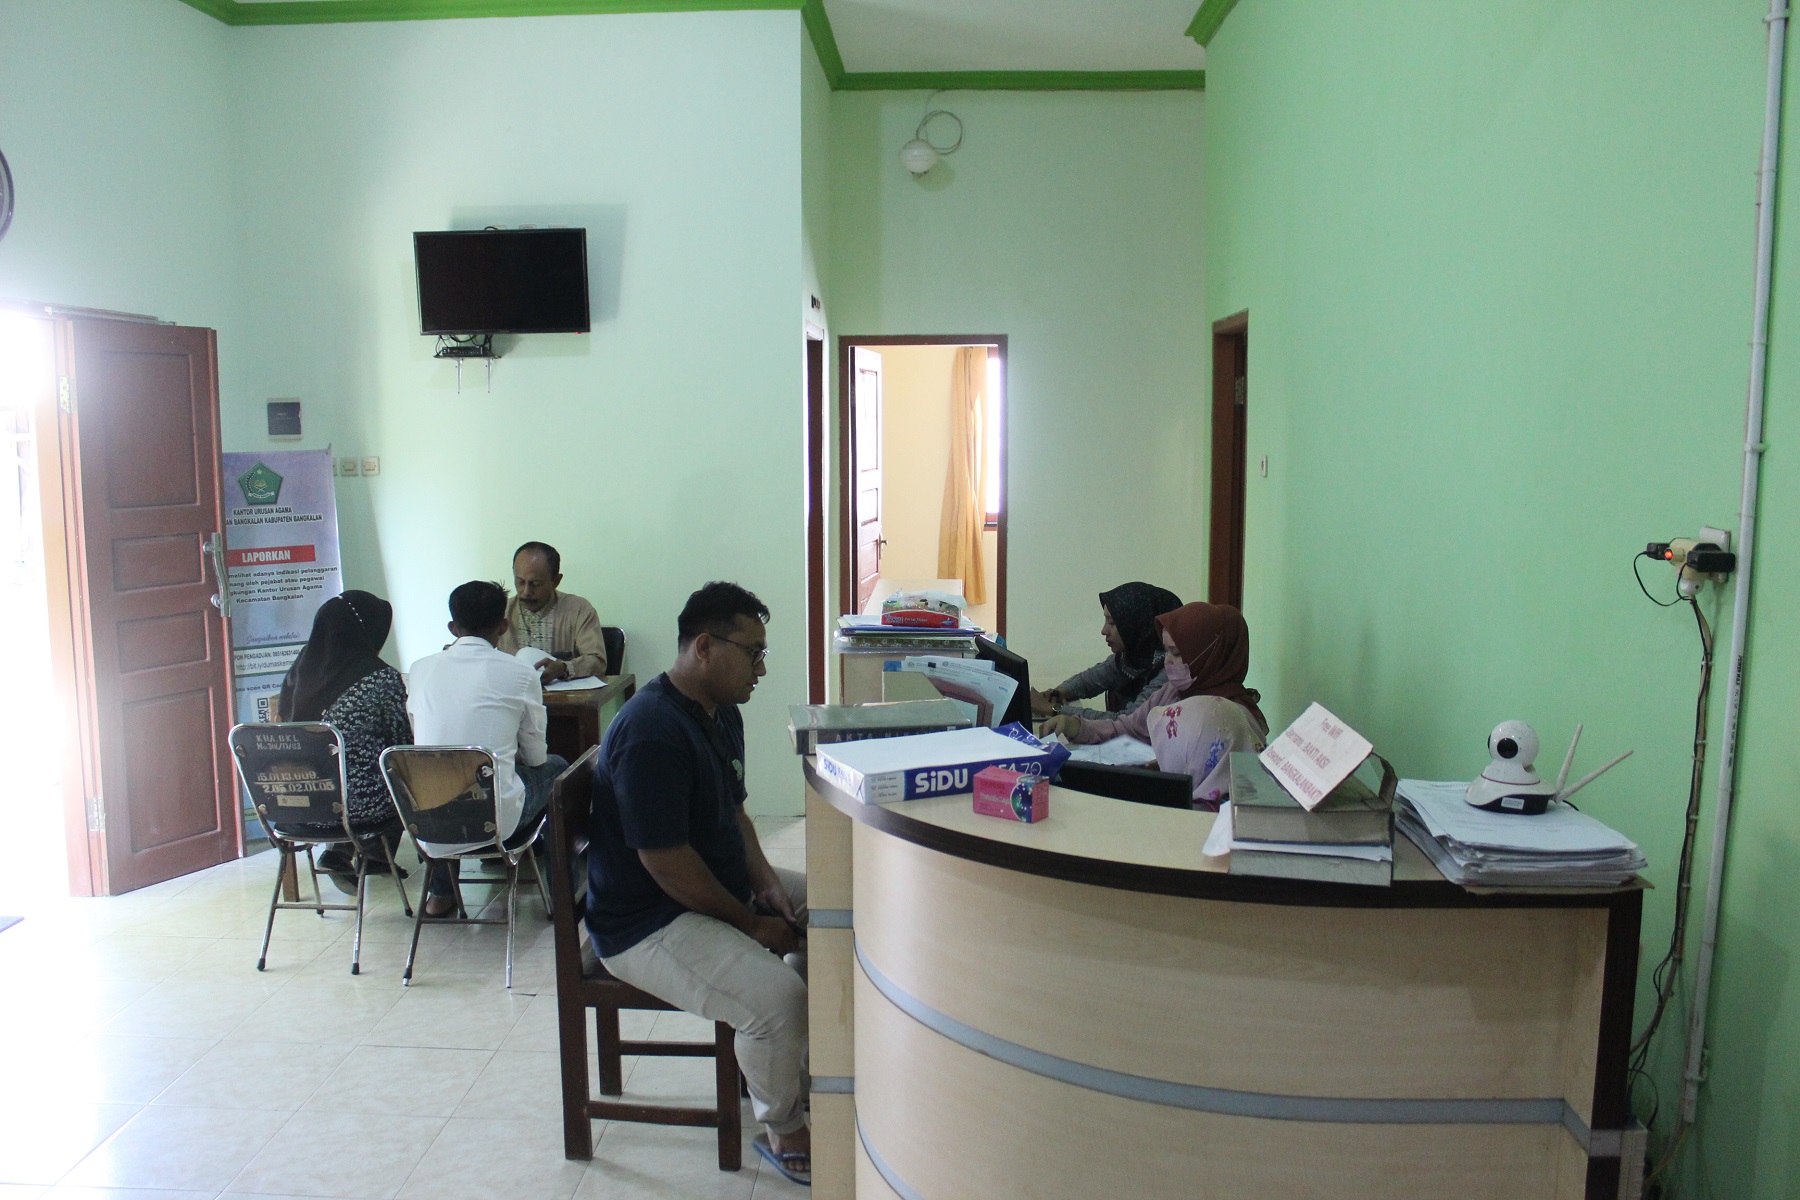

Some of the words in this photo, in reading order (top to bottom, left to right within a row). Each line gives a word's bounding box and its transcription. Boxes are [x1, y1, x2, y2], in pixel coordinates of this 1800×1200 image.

[233, 508, 253, 516] KANTOR
[254, 507, 274, 515] URUSAN
[275, 506, 293, 514] AGAMA
[233, 517, 264, 526] BANGKALAN
[264, 516, 293, 524] KABUPATEN
[293, 514, 323, 523] BANGKALAN
[241, 549, 291, 563] LAPORKAN
[276, 568, 300, 576] indikasi
[300, 566, 338, 575] pelanggaran
[260, 578, 283, 586] pejabat
[299, 575, 325, 584] pegawai
[279, 585, 301, 593] Urusan
[302, 584, 323, 592] Agama
[236, 596, 271, 604] Kecamatan
[272, 593, 304, 602] Bangkalan
[914, 768, 969, 794] SiDU
